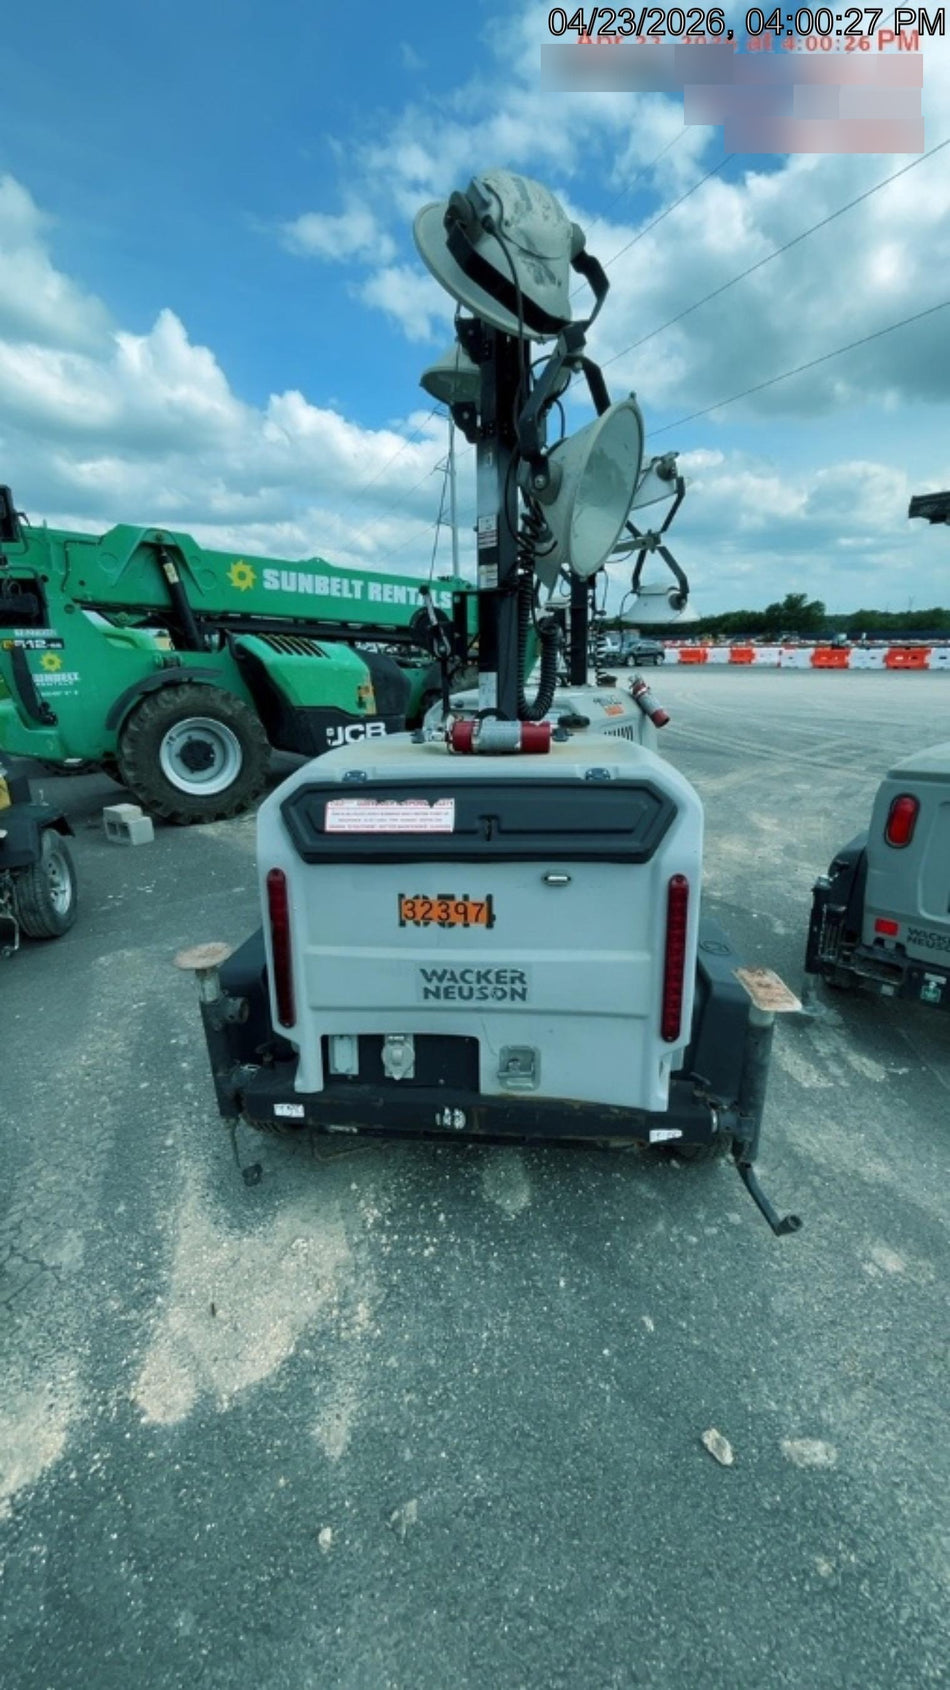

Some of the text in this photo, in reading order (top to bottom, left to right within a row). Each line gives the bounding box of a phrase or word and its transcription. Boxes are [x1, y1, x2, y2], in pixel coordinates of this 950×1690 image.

[262, 568, 365, 600] SUNBELT
[326, 722, 387, 746] JCB
[403, 899, 485, 923] 32397
[419, 967, 527, 985] WACKER
[423, 985, 528, 1002] NEUSON
